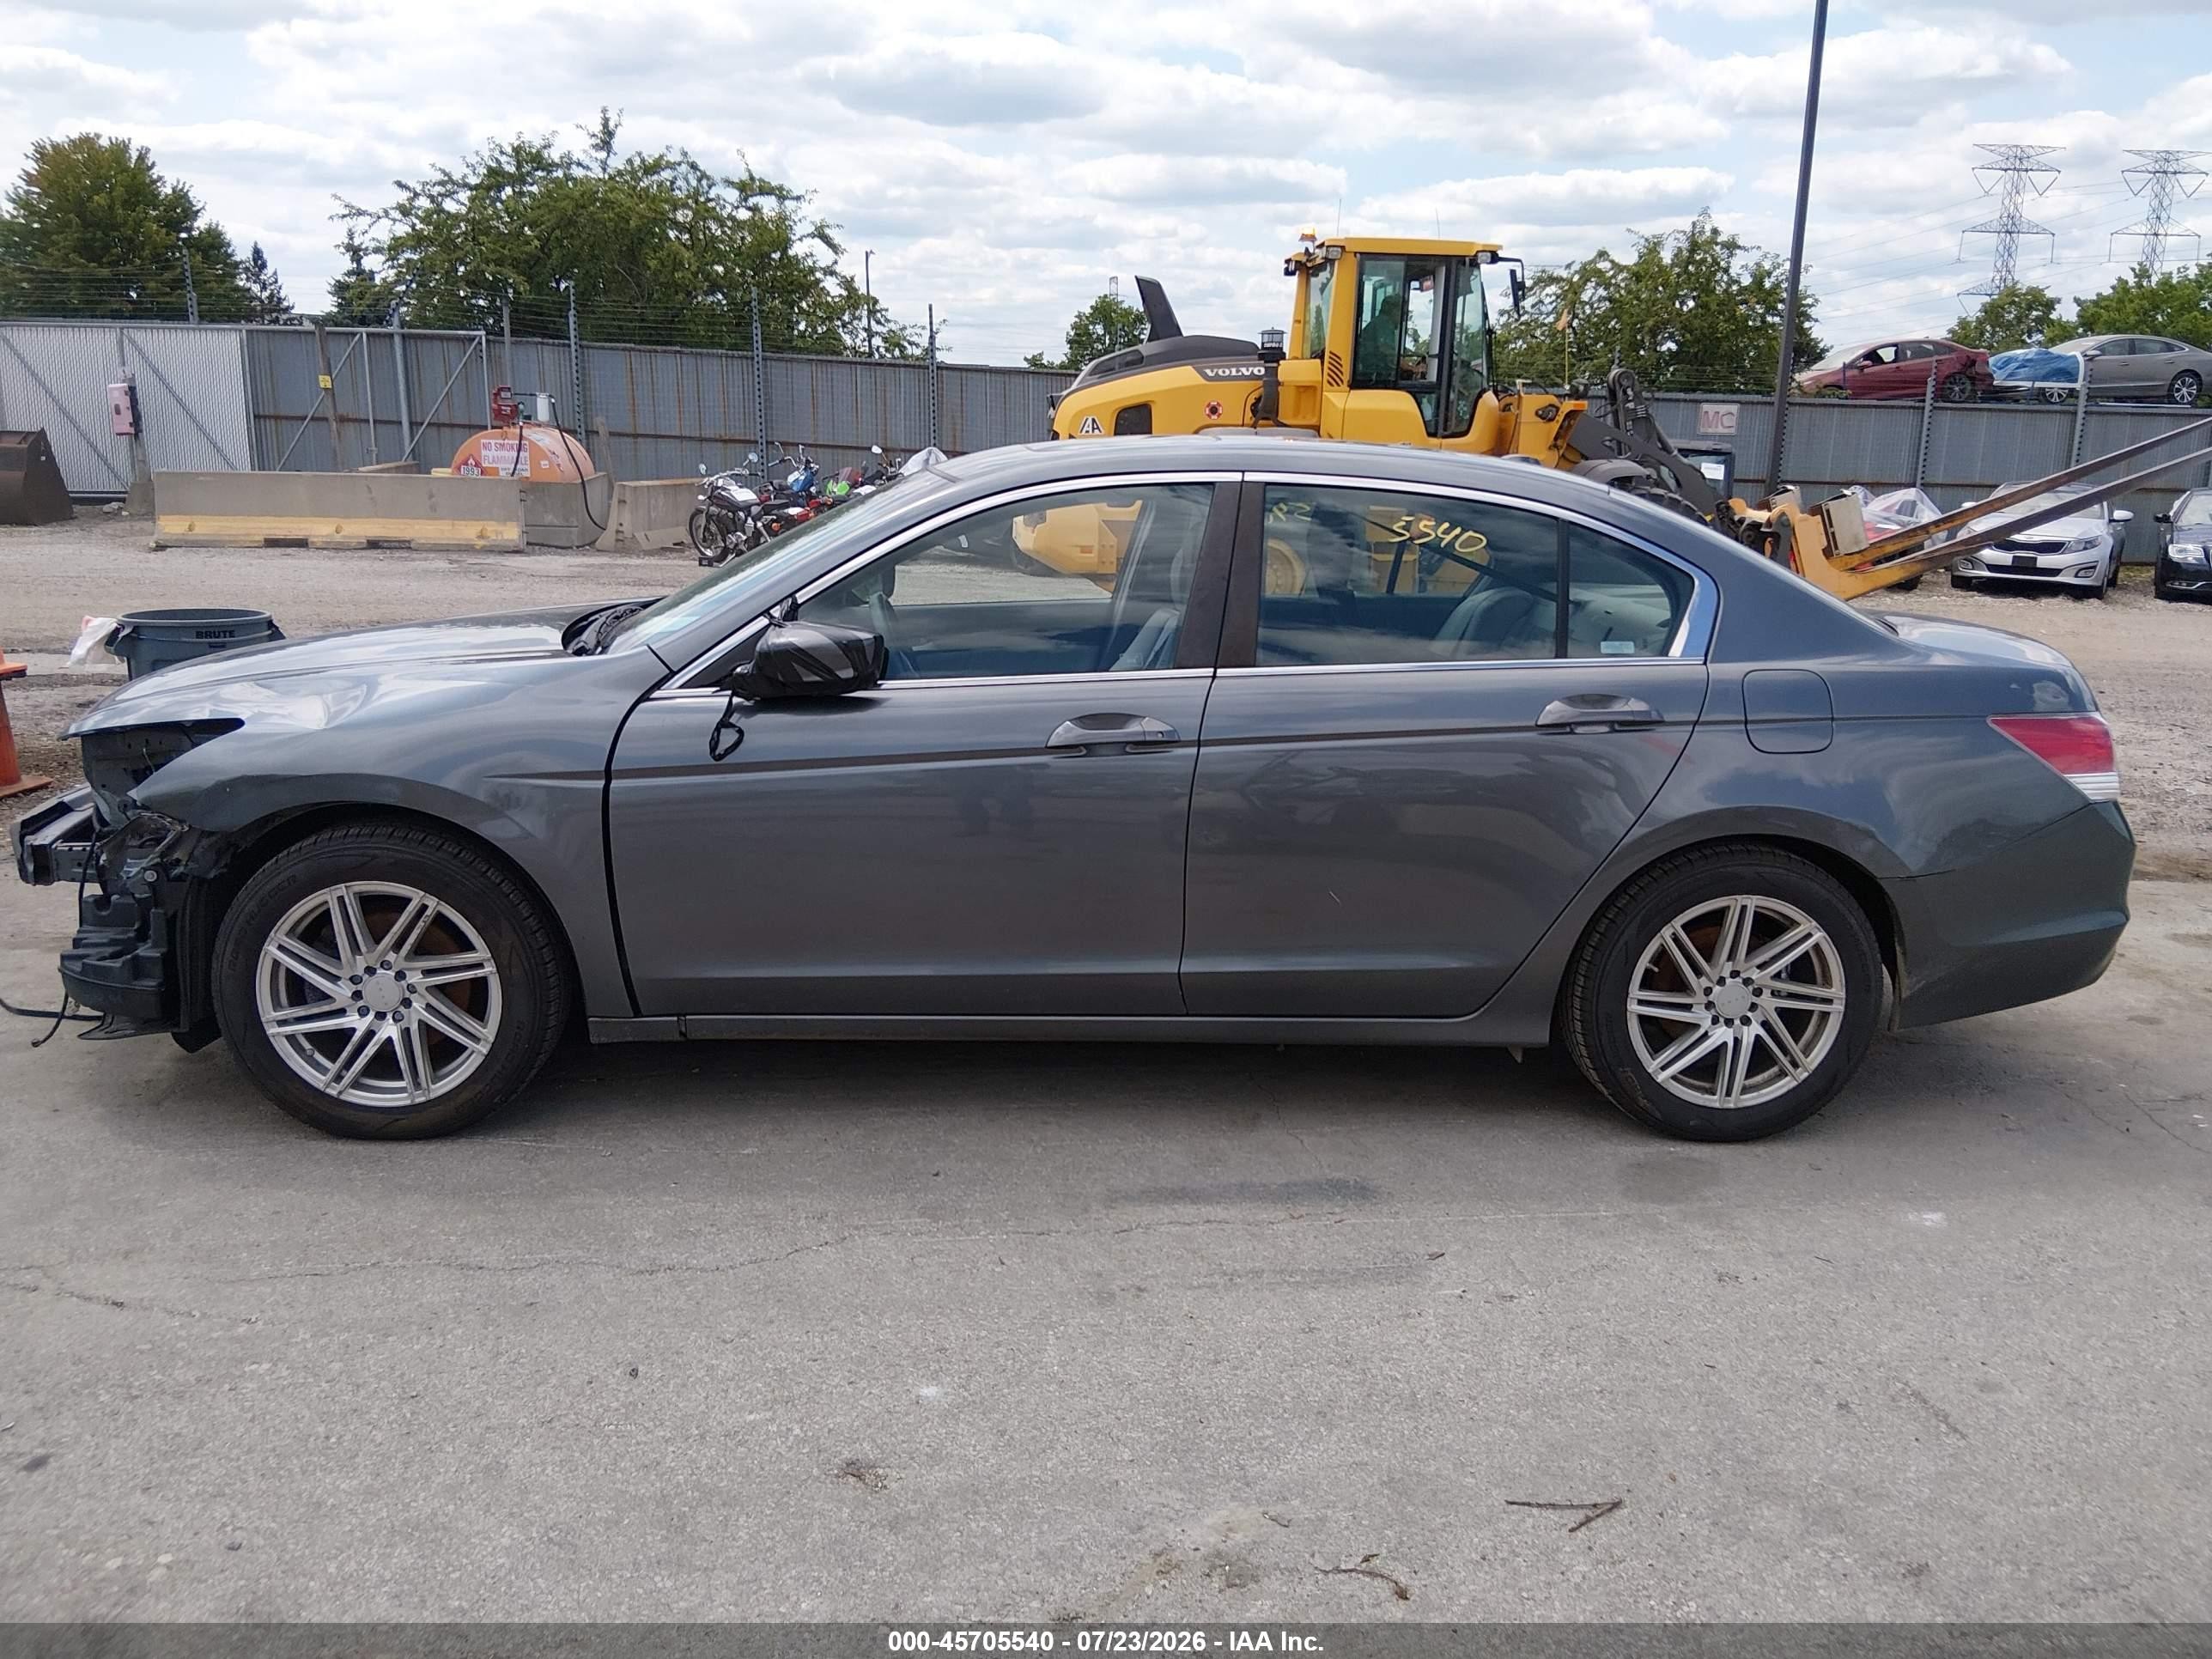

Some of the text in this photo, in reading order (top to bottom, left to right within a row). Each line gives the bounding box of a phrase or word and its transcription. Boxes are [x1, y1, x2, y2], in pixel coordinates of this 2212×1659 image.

[1203, 367, 1266, 377] VOLVO
[483, 441, 492, 452] NO
[463, 466, 480, 477] 1993
[1388, 516, 1487, 552] 5540
[195, 629, 235, 640] BRUTE
